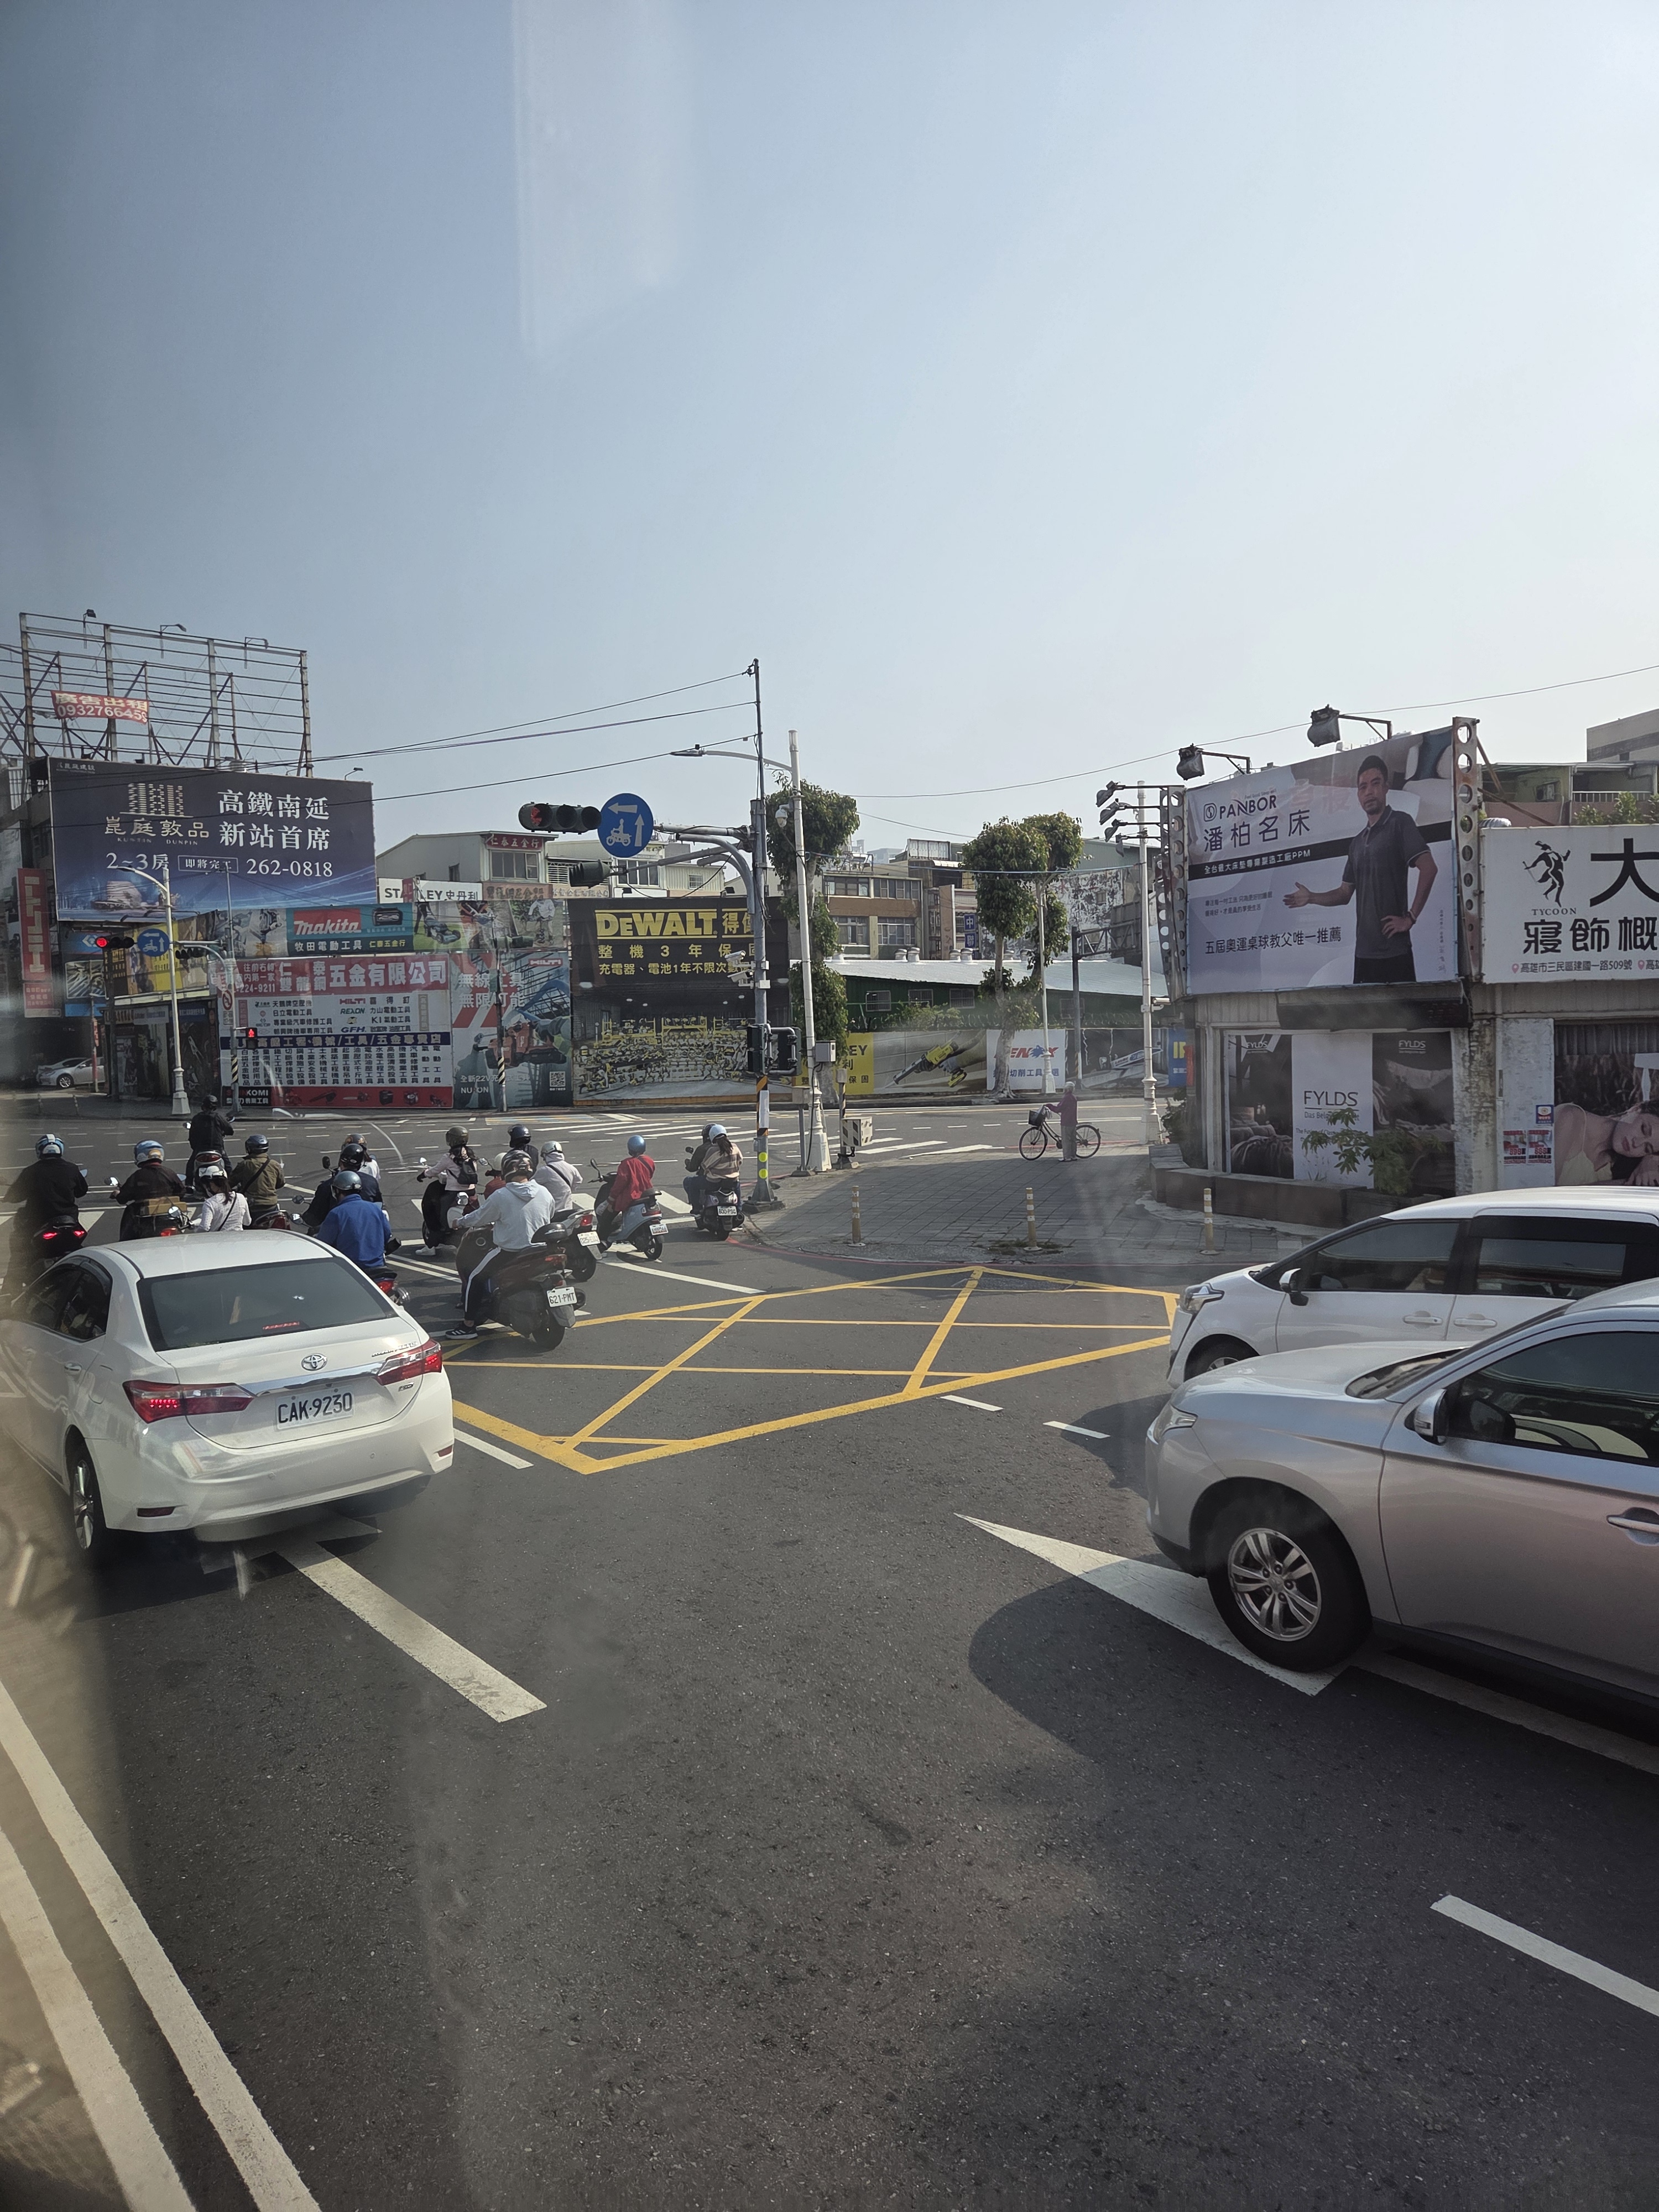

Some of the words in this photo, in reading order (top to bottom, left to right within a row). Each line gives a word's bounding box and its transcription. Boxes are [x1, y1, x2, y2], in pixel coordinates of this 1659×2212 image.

[55, 693, 147, 711] 廣告出租
[217, 789, 330, 820] 高鐵南延
[1219, 795, 1277, 820] PANBOR
[105, 816, 210, 838] 崑庭敦品
[1204, 809, 1310, 852] 潘柏名床
[219, 821, 331, 851] 新站首席
[247, 858, 333, 877] 262-0818
[1590, 838, 1659, 907] 大
[445, 890, 478, 901] 史丹利
[1531, 907, 1577, 916] TYCOON
[294, 940, 363, 953] 牧田電動工具
[1205, 926, 1342, 954] 五屆奧運桌球教父唯一推薦
[330, 961, 446, 988] 五金有限公司
[849, 1045, 868, 1056] EY
[994, 1047, 1059, 1058] ENX
[1399, 1040, 1426, 1048] FYLDS
[842, 1058, 853, 1071] 利
[993, 1068, 1060, 1078] 切削工具選
[1304, 1091, 1359, 1107] FYLDS
[549, 1292, 575, 1305] 621-PMT
